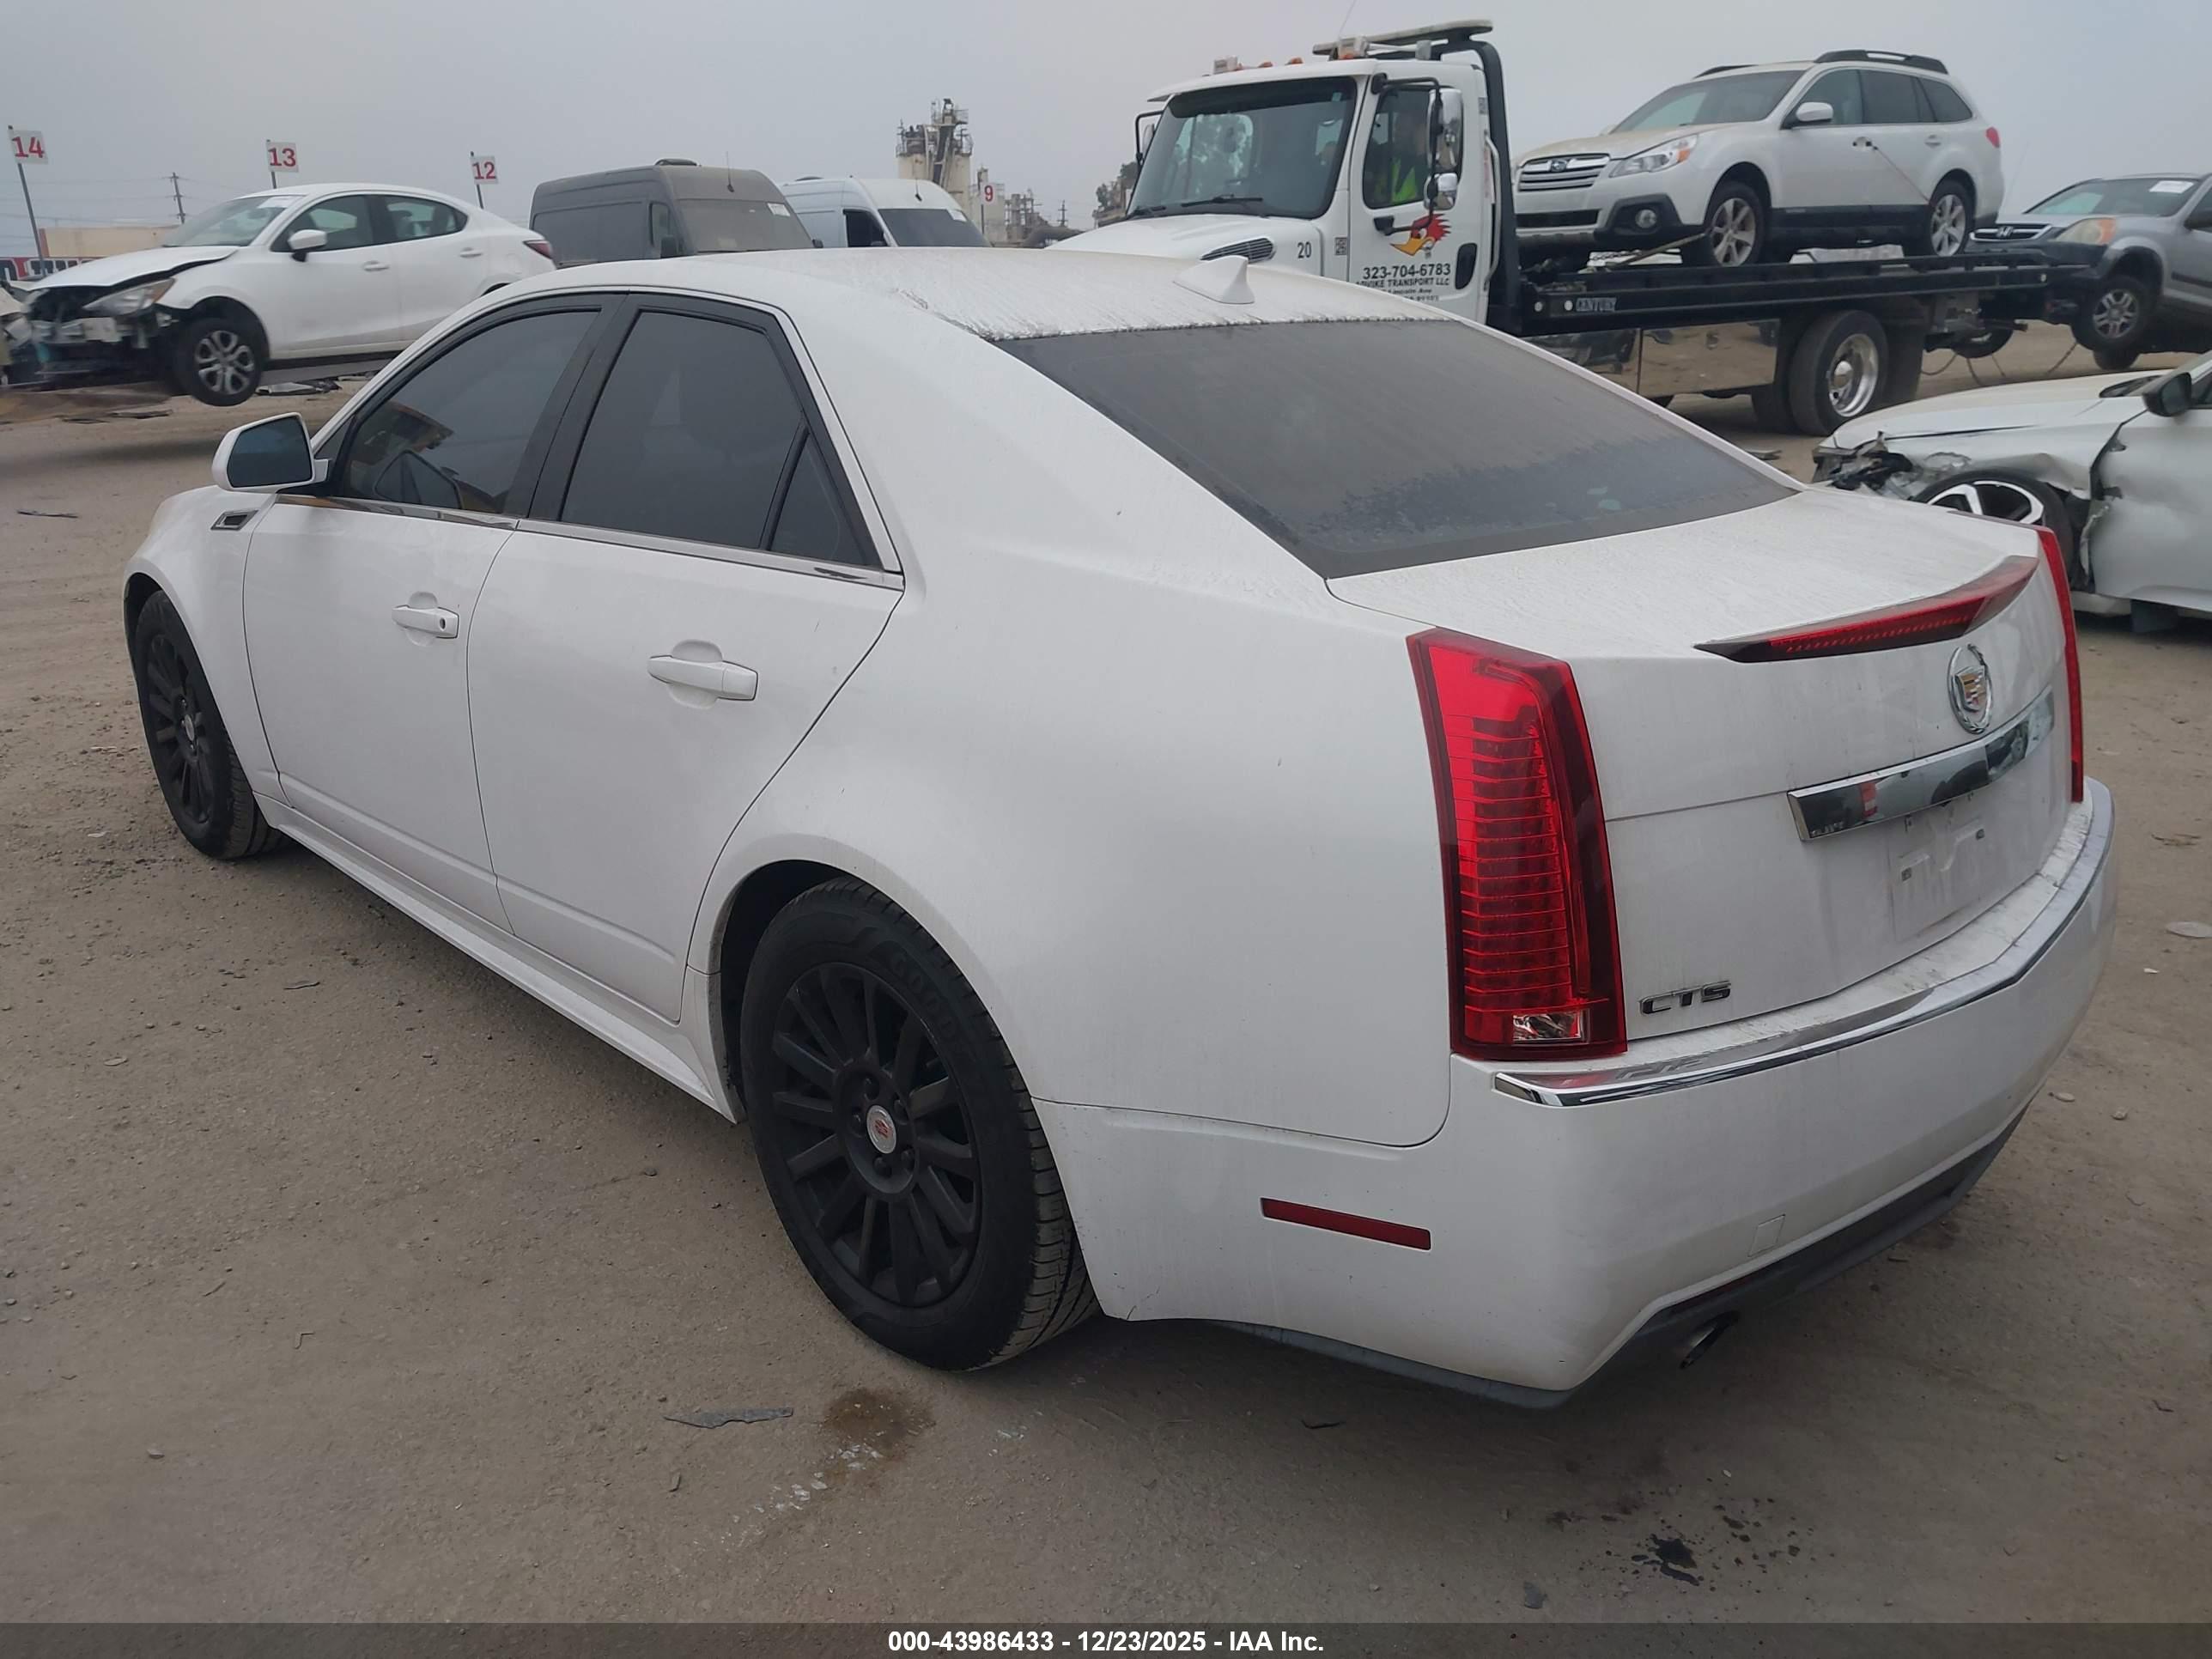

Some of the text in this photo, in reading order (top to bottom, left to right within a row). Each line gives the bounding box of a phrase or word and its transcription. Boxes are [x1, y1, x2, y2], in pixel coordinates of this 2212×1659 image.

[12, 137, 45, 158] 14
[268, 148, 296, 167] 13
[472, 161, 496, 179] 12
[984, 185, 994, 202] 9
[1297, 241, 1312, 258] 20
[1363, 263, 1451, 280] 323-704-6783
[1388, 277, 1434, 287] TRANSPORT
[1436, 276, 1450, 286] LLC
[1639, 980, 1732, 1016] CTS
